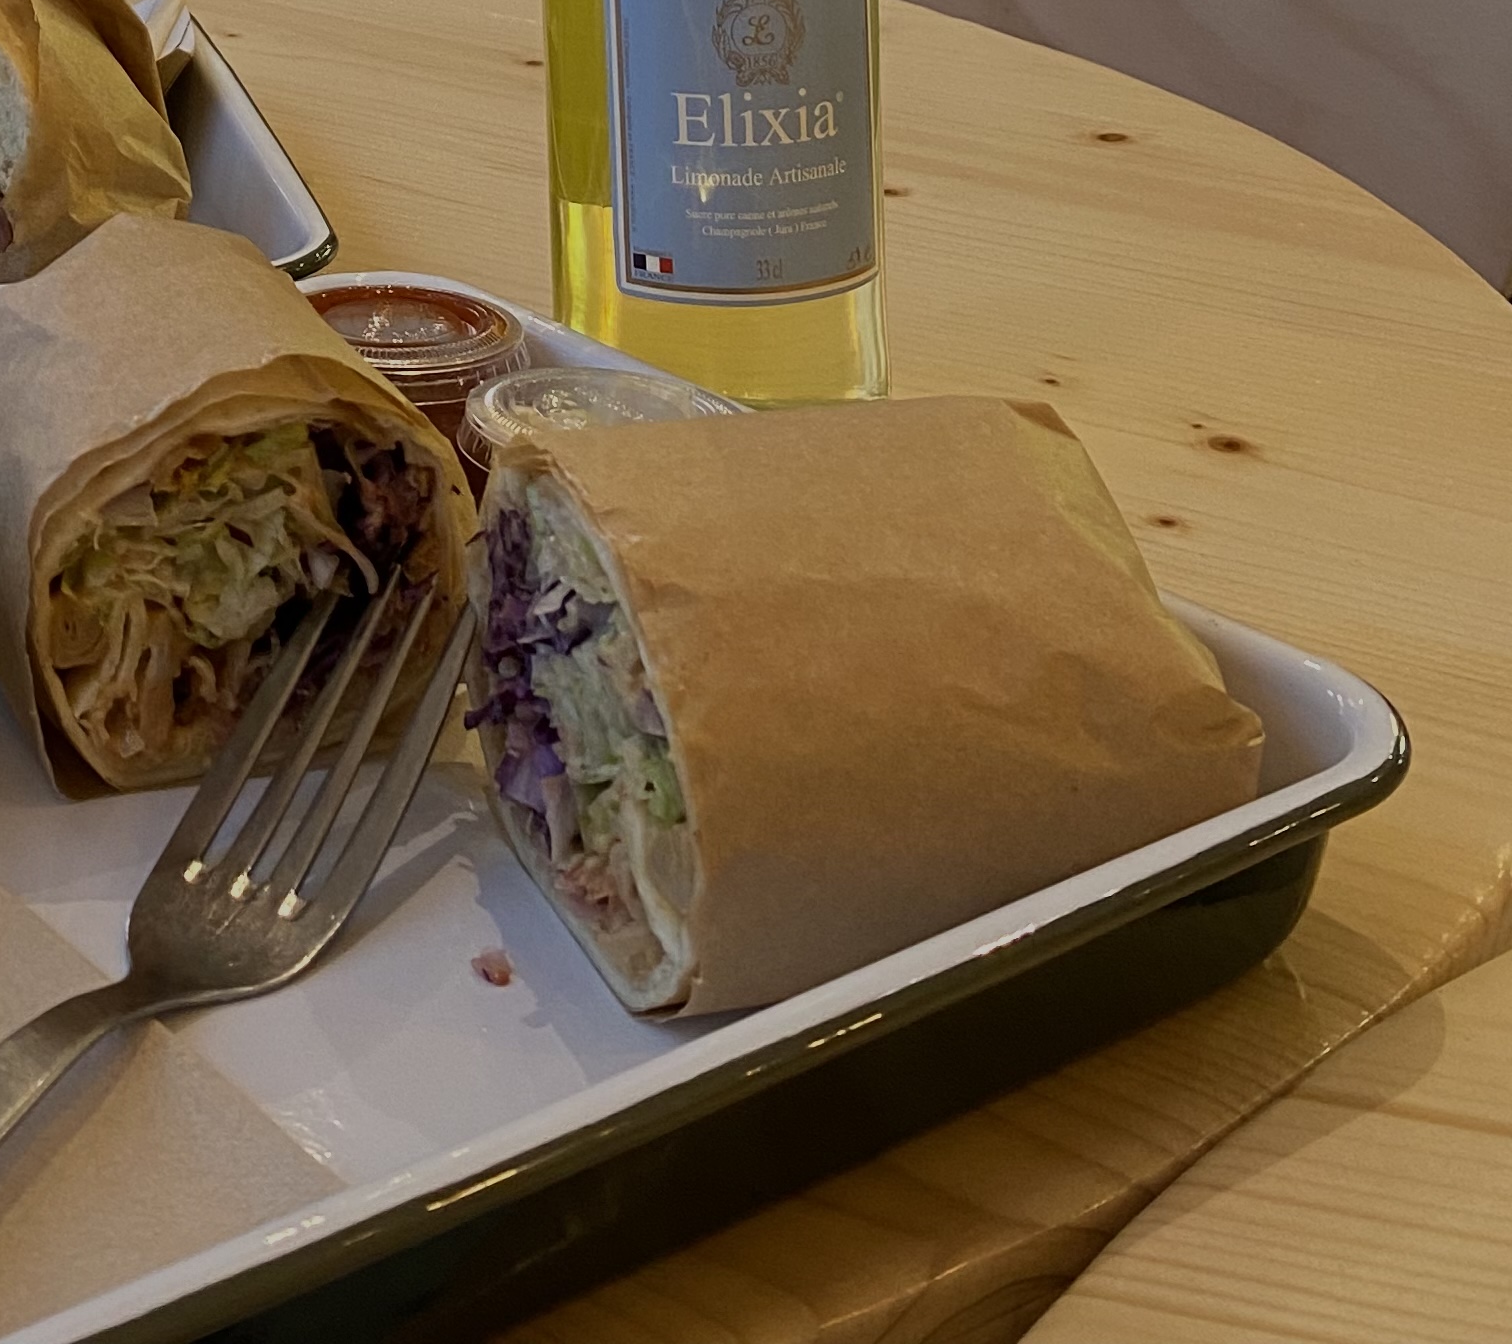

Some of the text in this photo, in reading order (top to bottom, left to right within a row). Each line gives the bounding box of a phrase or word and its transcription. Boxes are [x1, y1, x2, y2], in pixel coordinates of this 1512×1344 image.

[671, 88, 838, 148] Elixia
[671, 156, 847, 187] Limonade Artisanale
